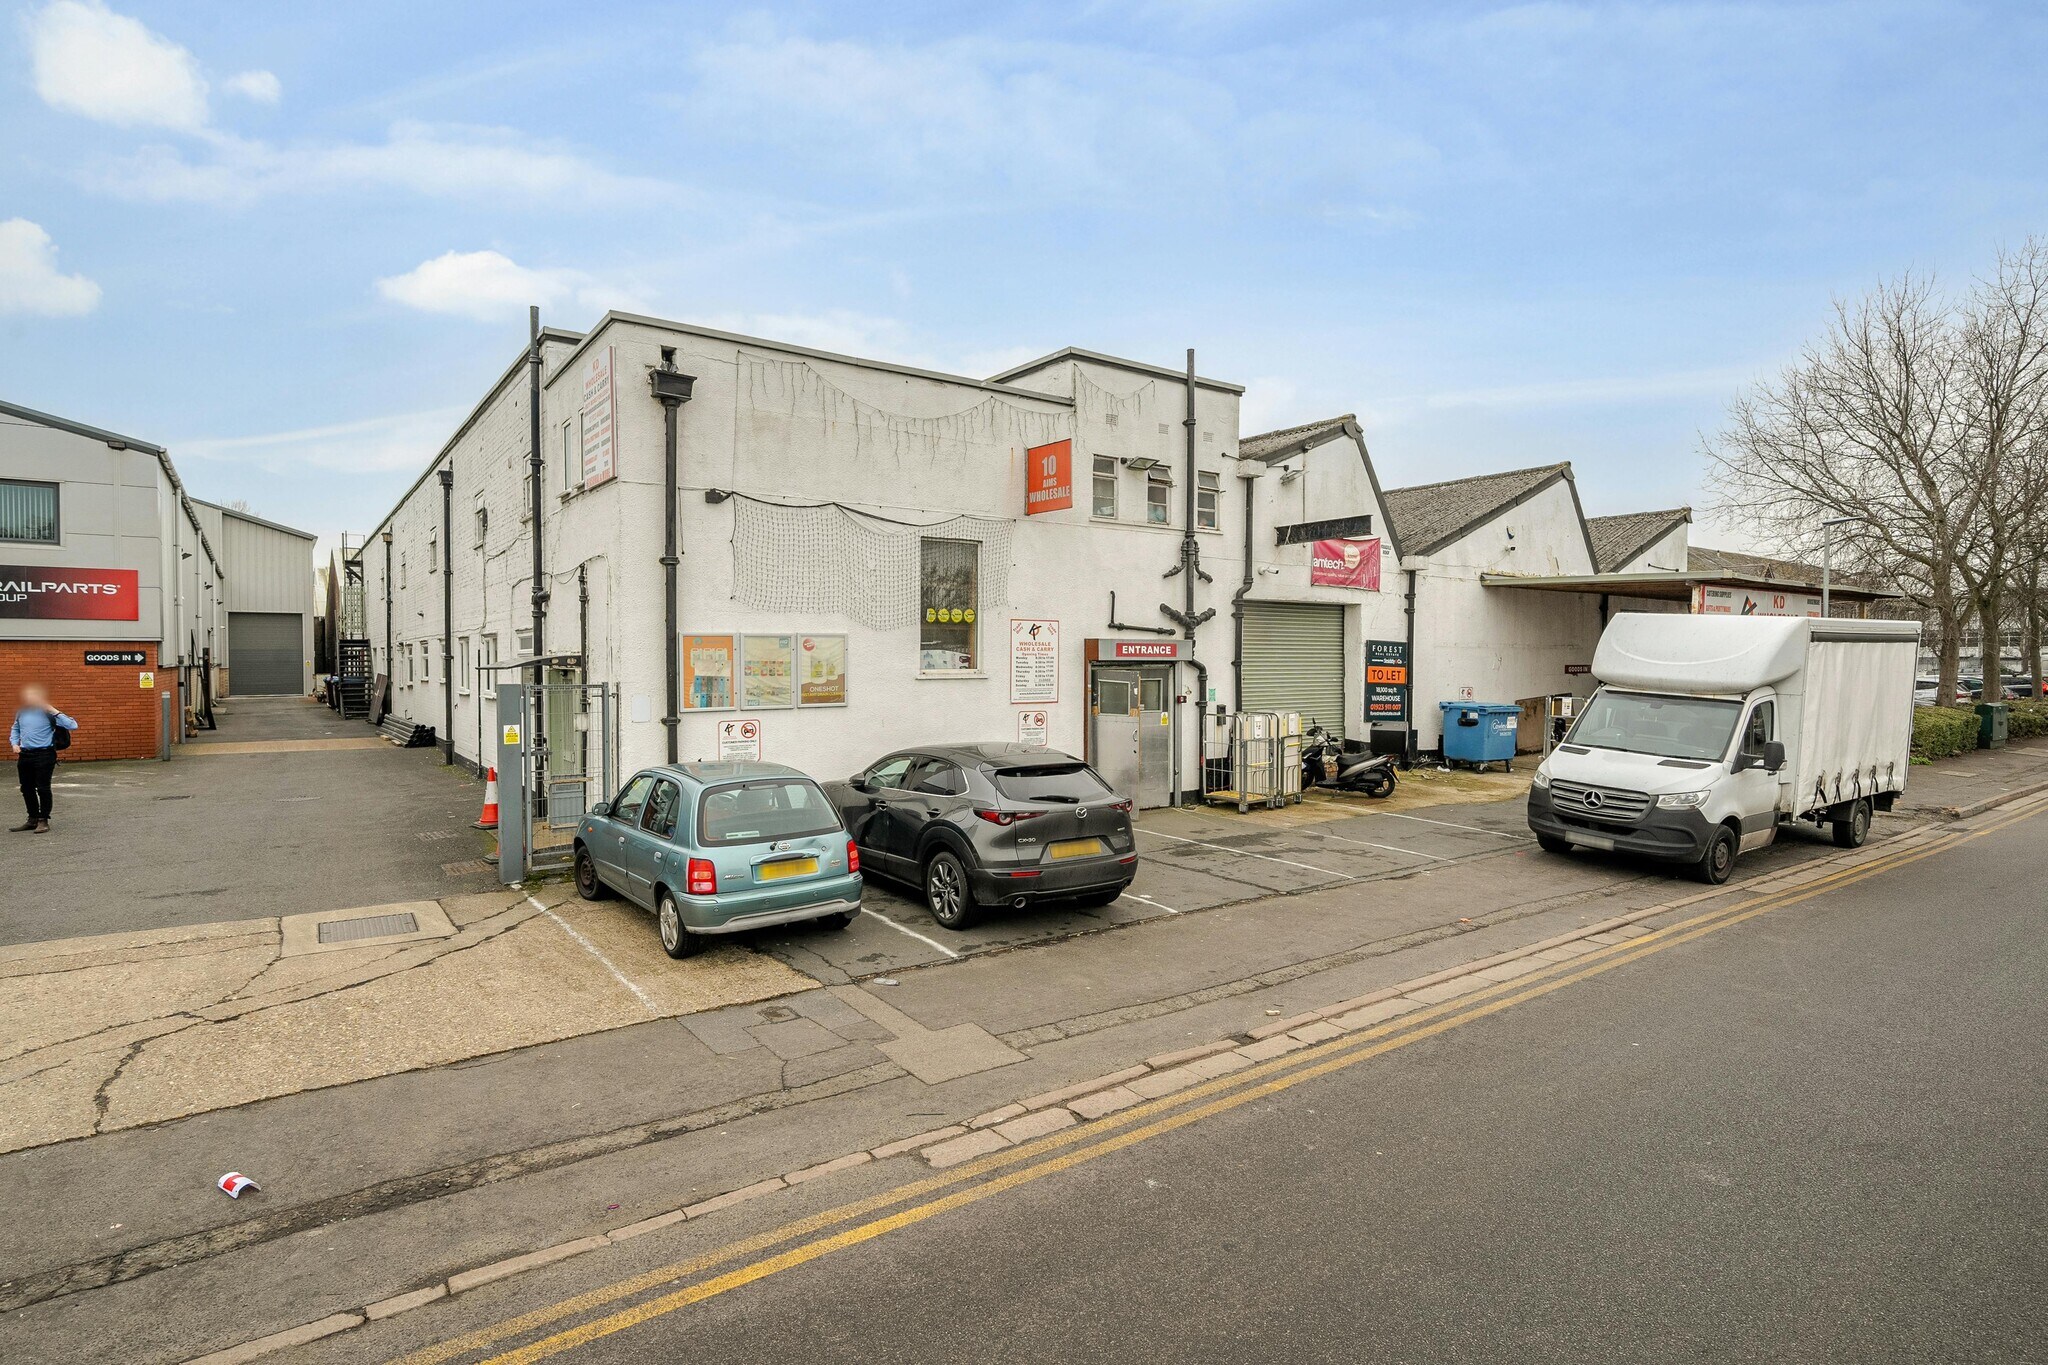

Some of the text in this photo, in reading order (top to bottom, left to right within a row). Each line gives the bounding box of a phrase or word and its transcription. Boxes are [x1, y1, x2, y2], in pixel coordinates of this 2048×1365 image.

[1042, 454, 1057, 477] 10
[1043, 477, 1057, 488] AIMS
[1029, 485, 1070, 503] WHOLESALE
[1313, 557, 1344, 570] amtech
[0, 581, 118, 595] AILPARTS
[1773, 595, 1785, 609] KD
[1122, 646, 1171, 654] ENTRANCE
[1372, 645, 1402, 653] FOREST
[1372, 670, 1401, 680] TO LET
